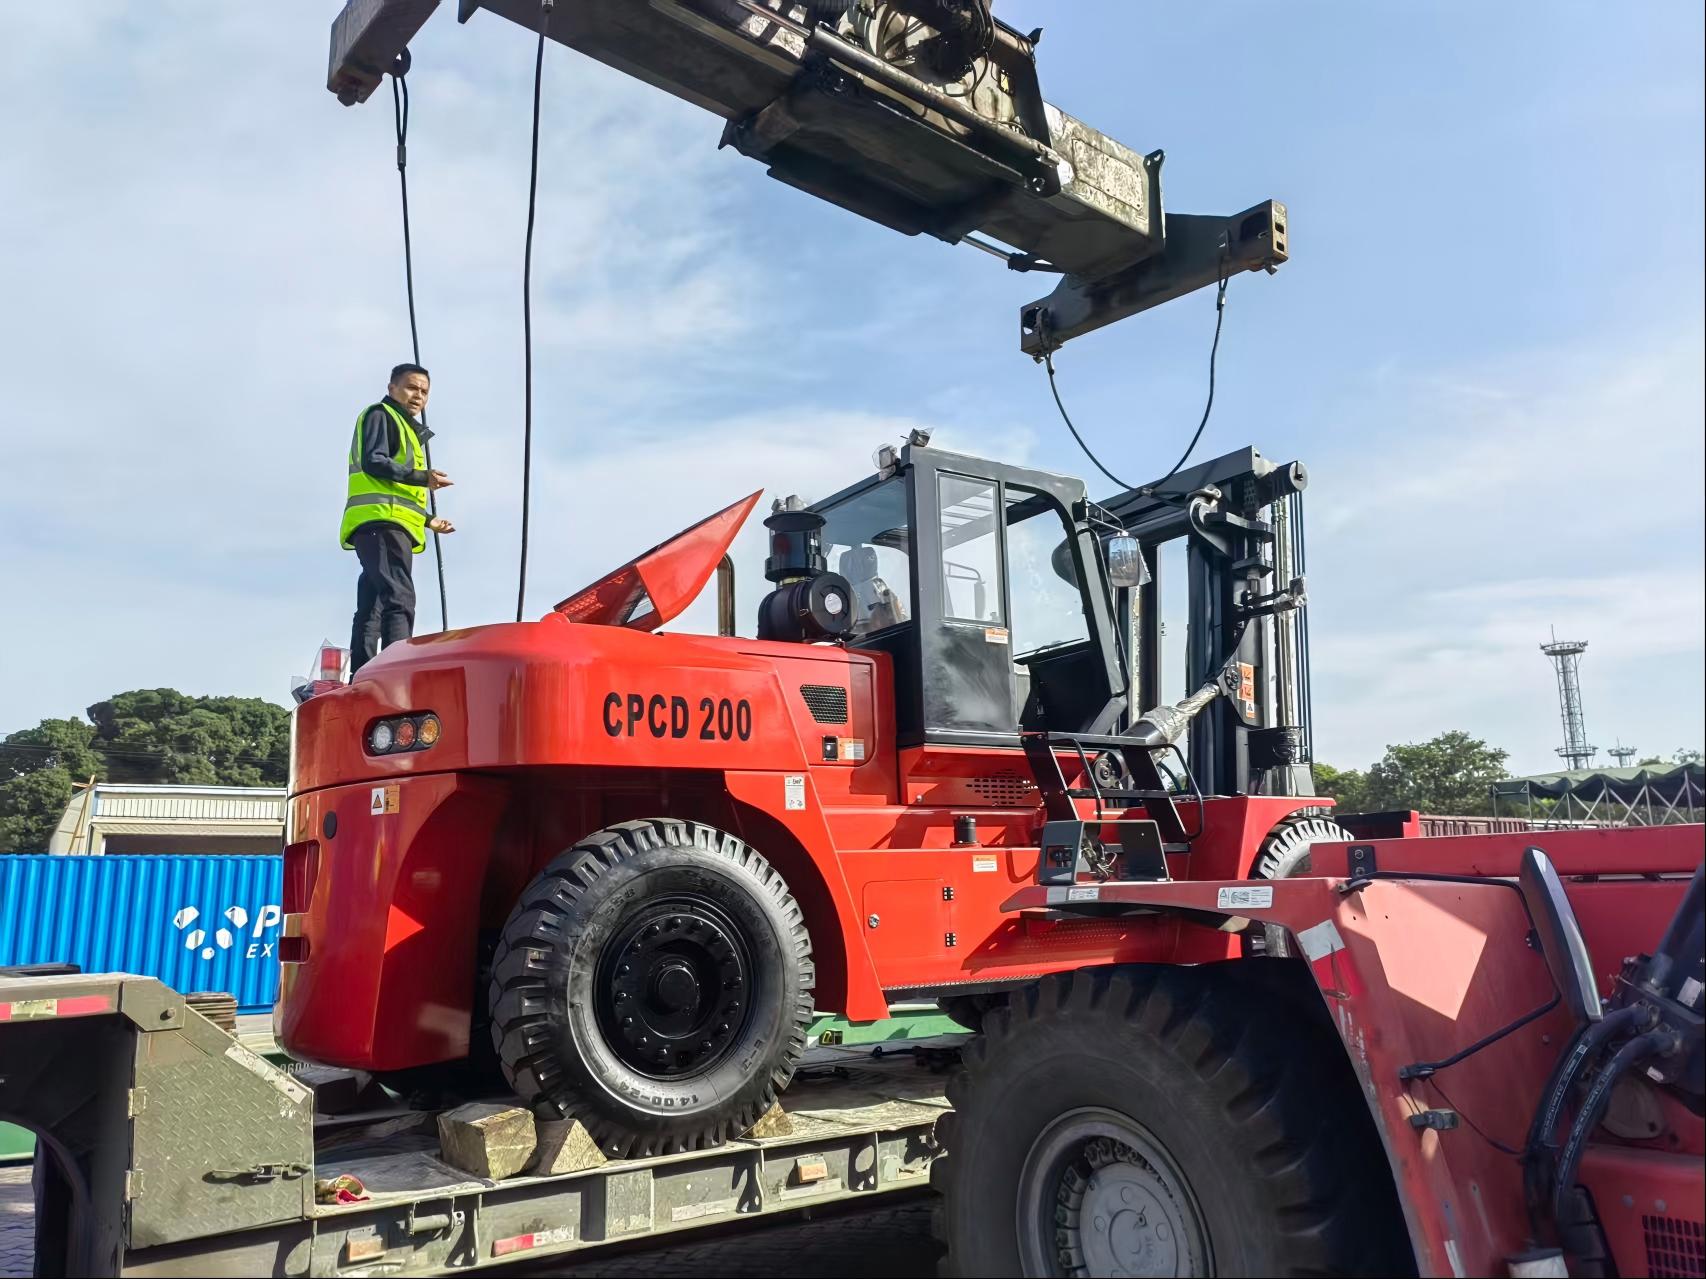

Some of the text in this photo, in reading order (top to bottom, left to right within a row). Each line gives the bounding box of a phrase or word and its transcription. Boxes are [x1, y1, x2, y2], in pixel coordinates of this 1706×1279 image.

[603, 692, 751, 741] CPCD 200
[252, 904, 281, 938] P
[620, 1081, 699, 1107] 14.00-24
